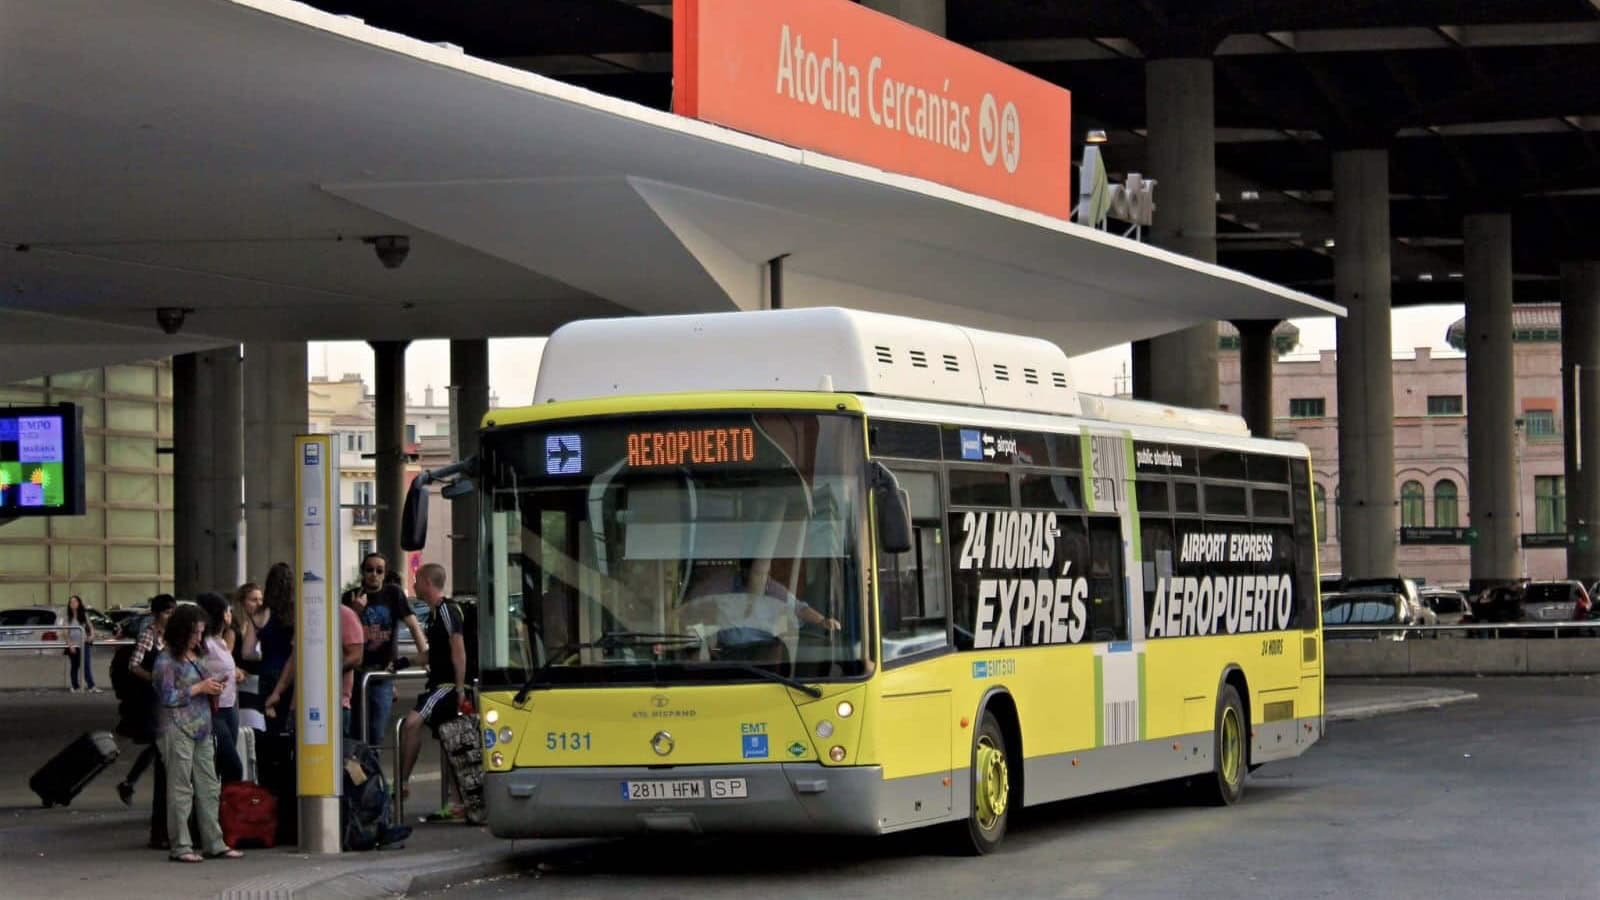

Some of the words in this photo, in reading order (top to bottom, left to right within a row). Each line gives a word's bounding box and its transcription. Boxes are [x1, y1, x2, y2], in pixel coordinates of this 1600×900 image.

[776, 24, 860, 119] Atocha
[867, 56, 971, 153] Cercanías
[627, 428, 754, 467] AEROPUERTO
[996, 434, 1018, 457] airport
[1136, 447, 1153, 468] public
[1153, 448, 1172, 467] shuttle
[1172, 450, 1182, 468] bus
[960, 511, 988, 569] 24
[990, 511, 1057, 569] HORAS
[1180, 533, 1227, 562] AIRPORT
[1229, 533, 1273, 562] EXPRESS
[974, 561, 1088, 648] EXPRÉS
[1149, 574, 1293, 637] AEROPUERTO
[1261, 639, 1268, 656] 24
[741, 722, 768, 733] EMT
[546, 732, 591, 751] 5131
[632, 784, 665, 799] 2811
[673, 782, 700, 797] HFM
[714, 781, 742, 797] SP
